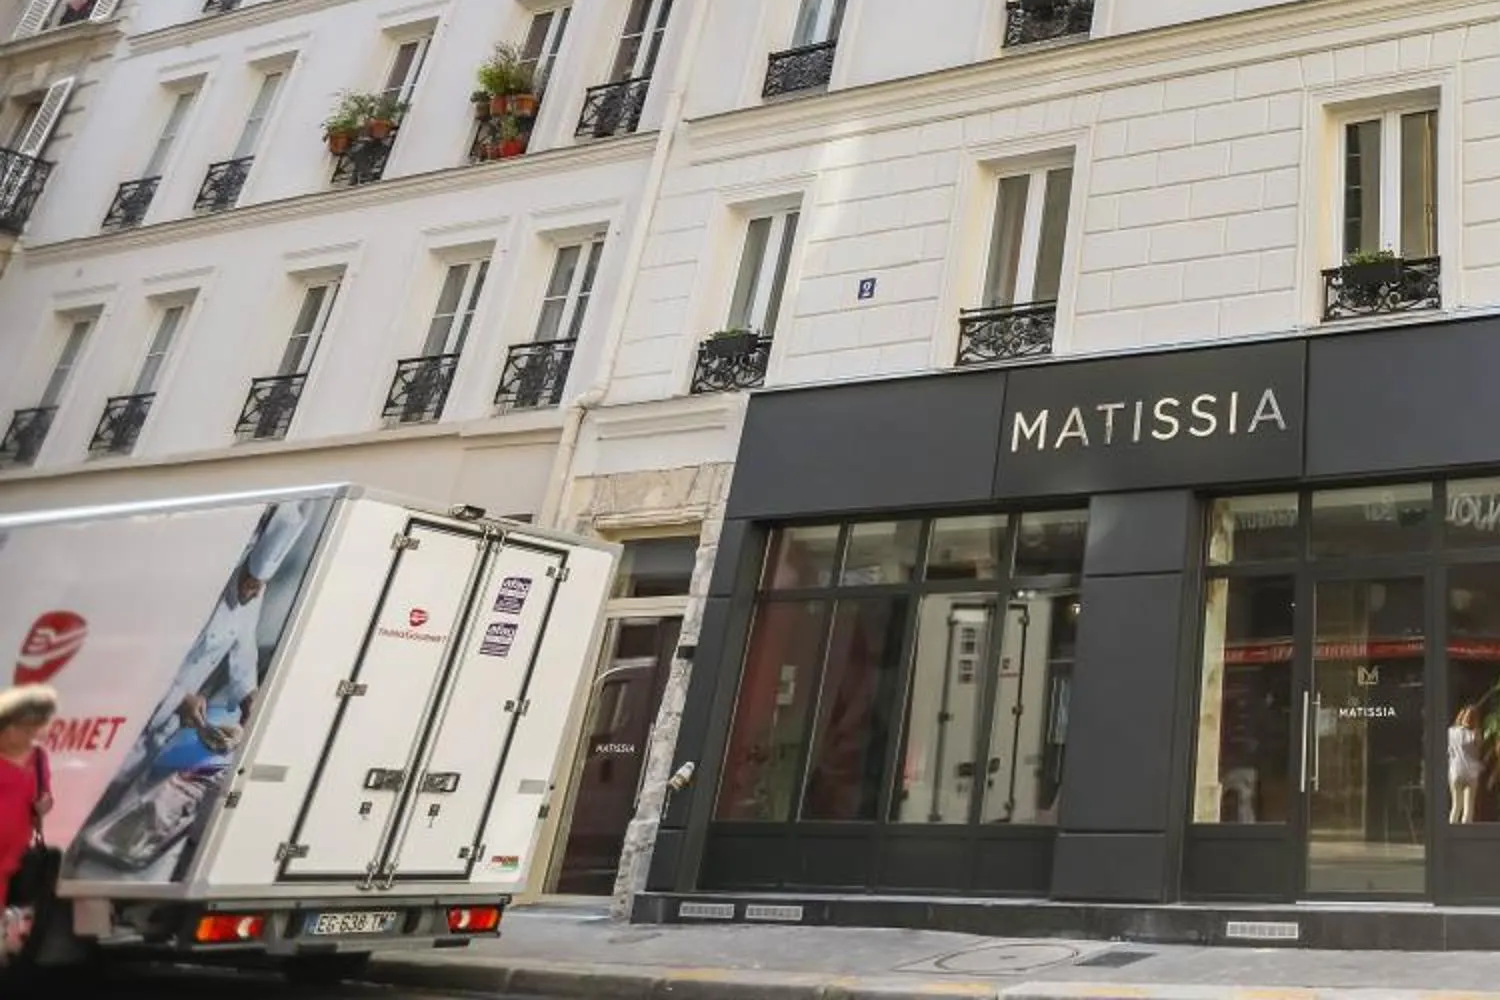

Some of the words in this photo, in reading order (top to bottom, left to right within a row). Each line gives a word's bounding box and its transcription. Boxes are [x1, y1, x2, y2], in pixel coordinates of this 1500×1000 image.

[1010, 387, 1287, 453] MATISSIA
[1339, 706, 1397, 718] MATISSIA
[48, 716, 128, 753] RMET
